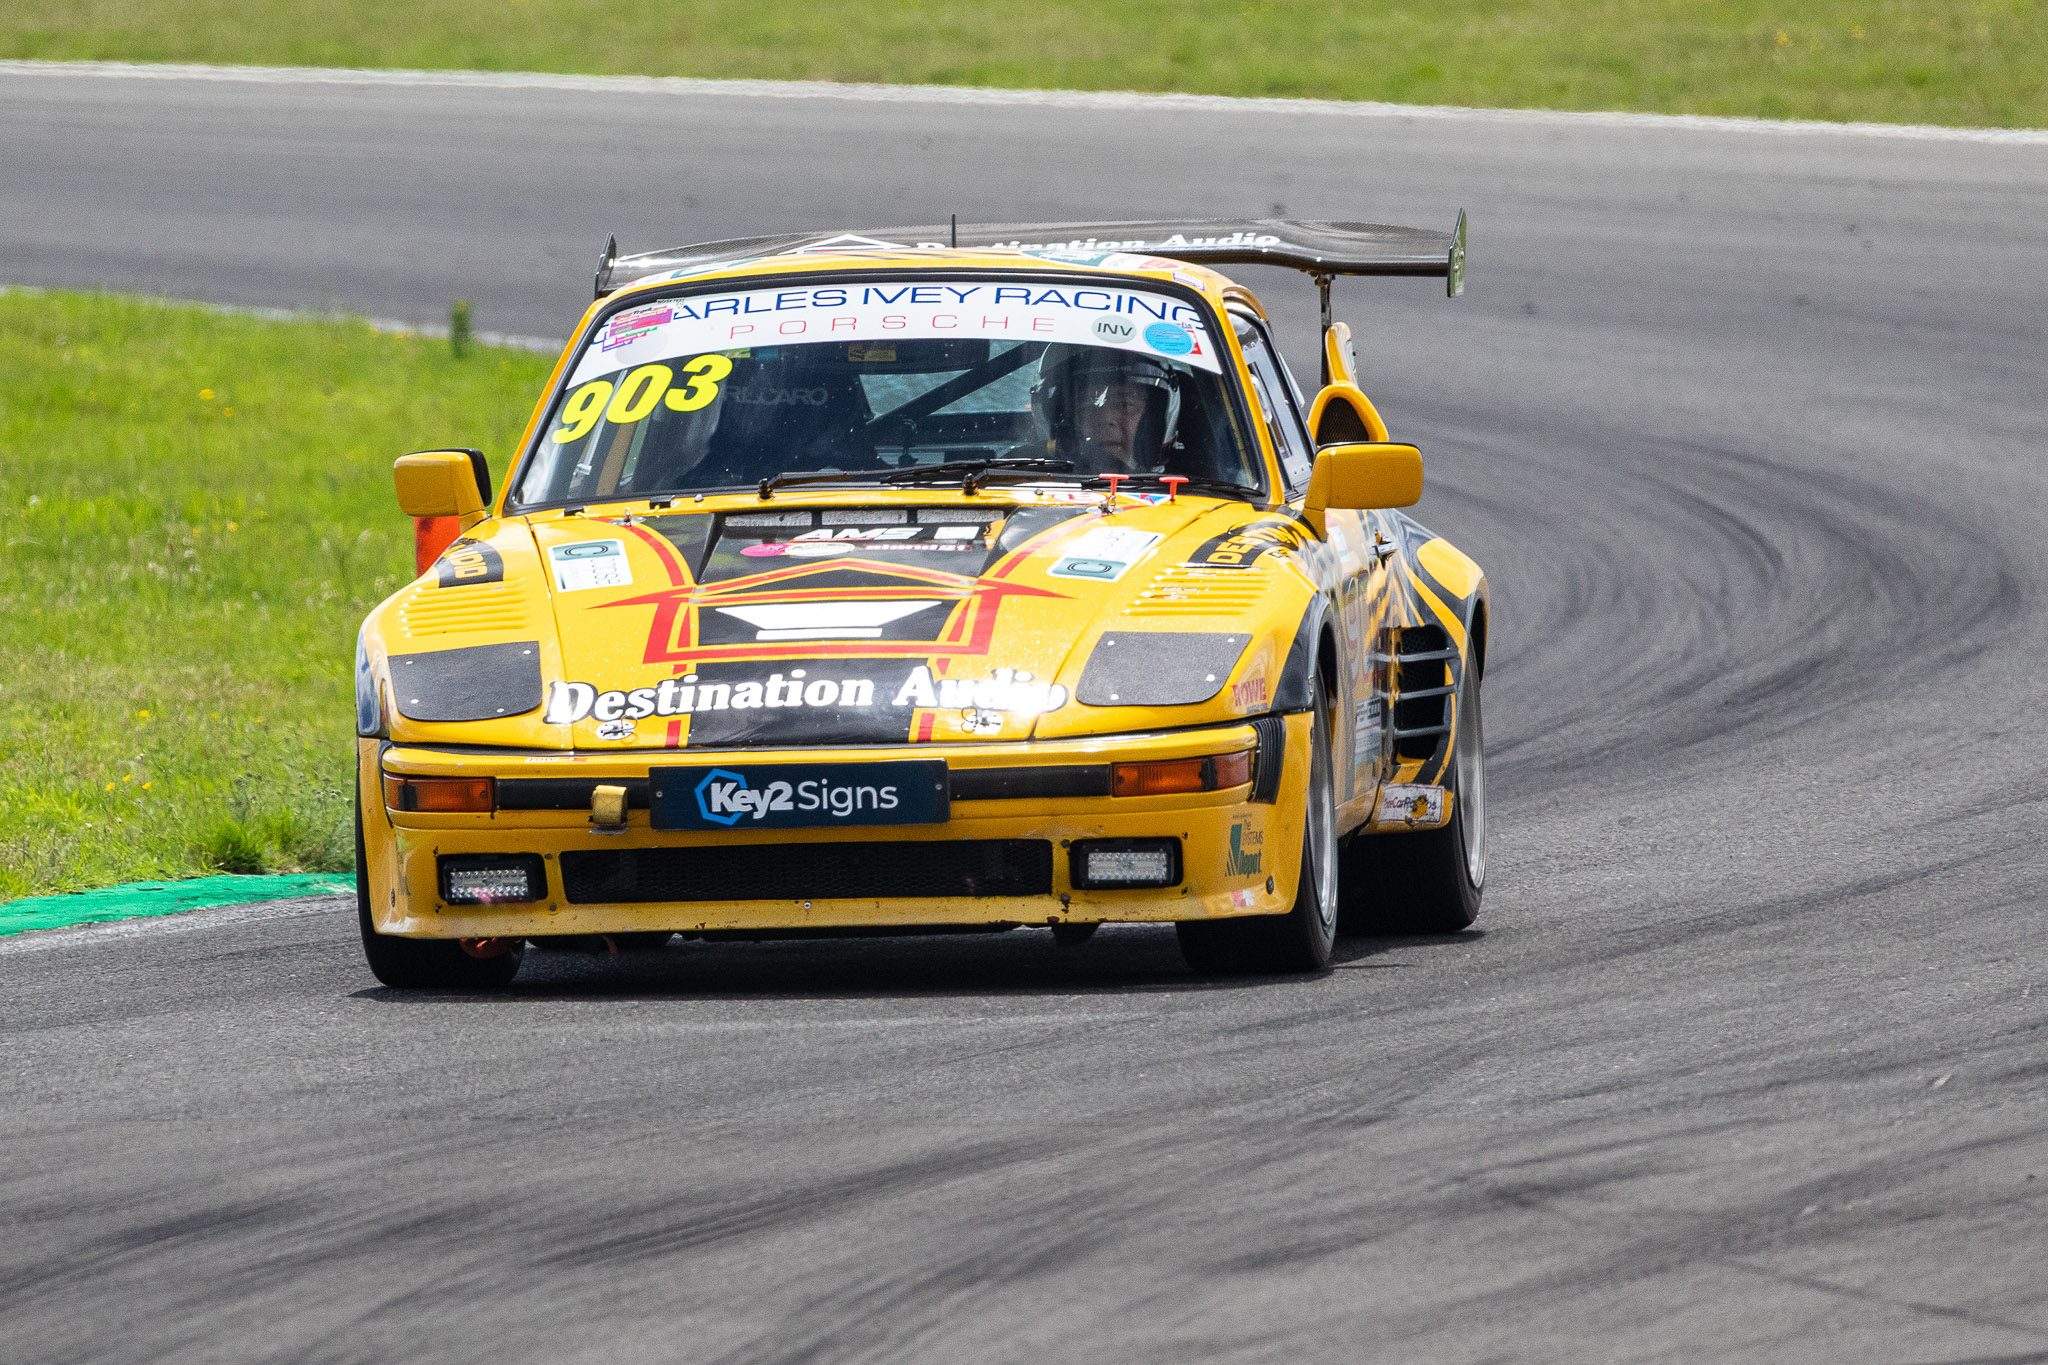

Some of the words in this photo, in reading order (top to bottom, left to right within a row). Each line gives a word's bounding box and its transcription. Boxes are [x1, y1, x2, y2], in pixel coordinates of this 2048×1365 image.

[916, 238, 1145, 249] tination
[1159, 232, 1281, 247] Audio
[863, 286, 983, 305] IVEY
[730, 315, 1055, 340] PORSCHE
[1097, 322, 1133, 337] INV
[552, 354, 733, 444] 903
[793, 527, 924, 540] AMS
[547, 669, 875, 723] Destination
[892, 665, 1068, 713] Audio
[1231, 678, 1266, 706] ROWE
